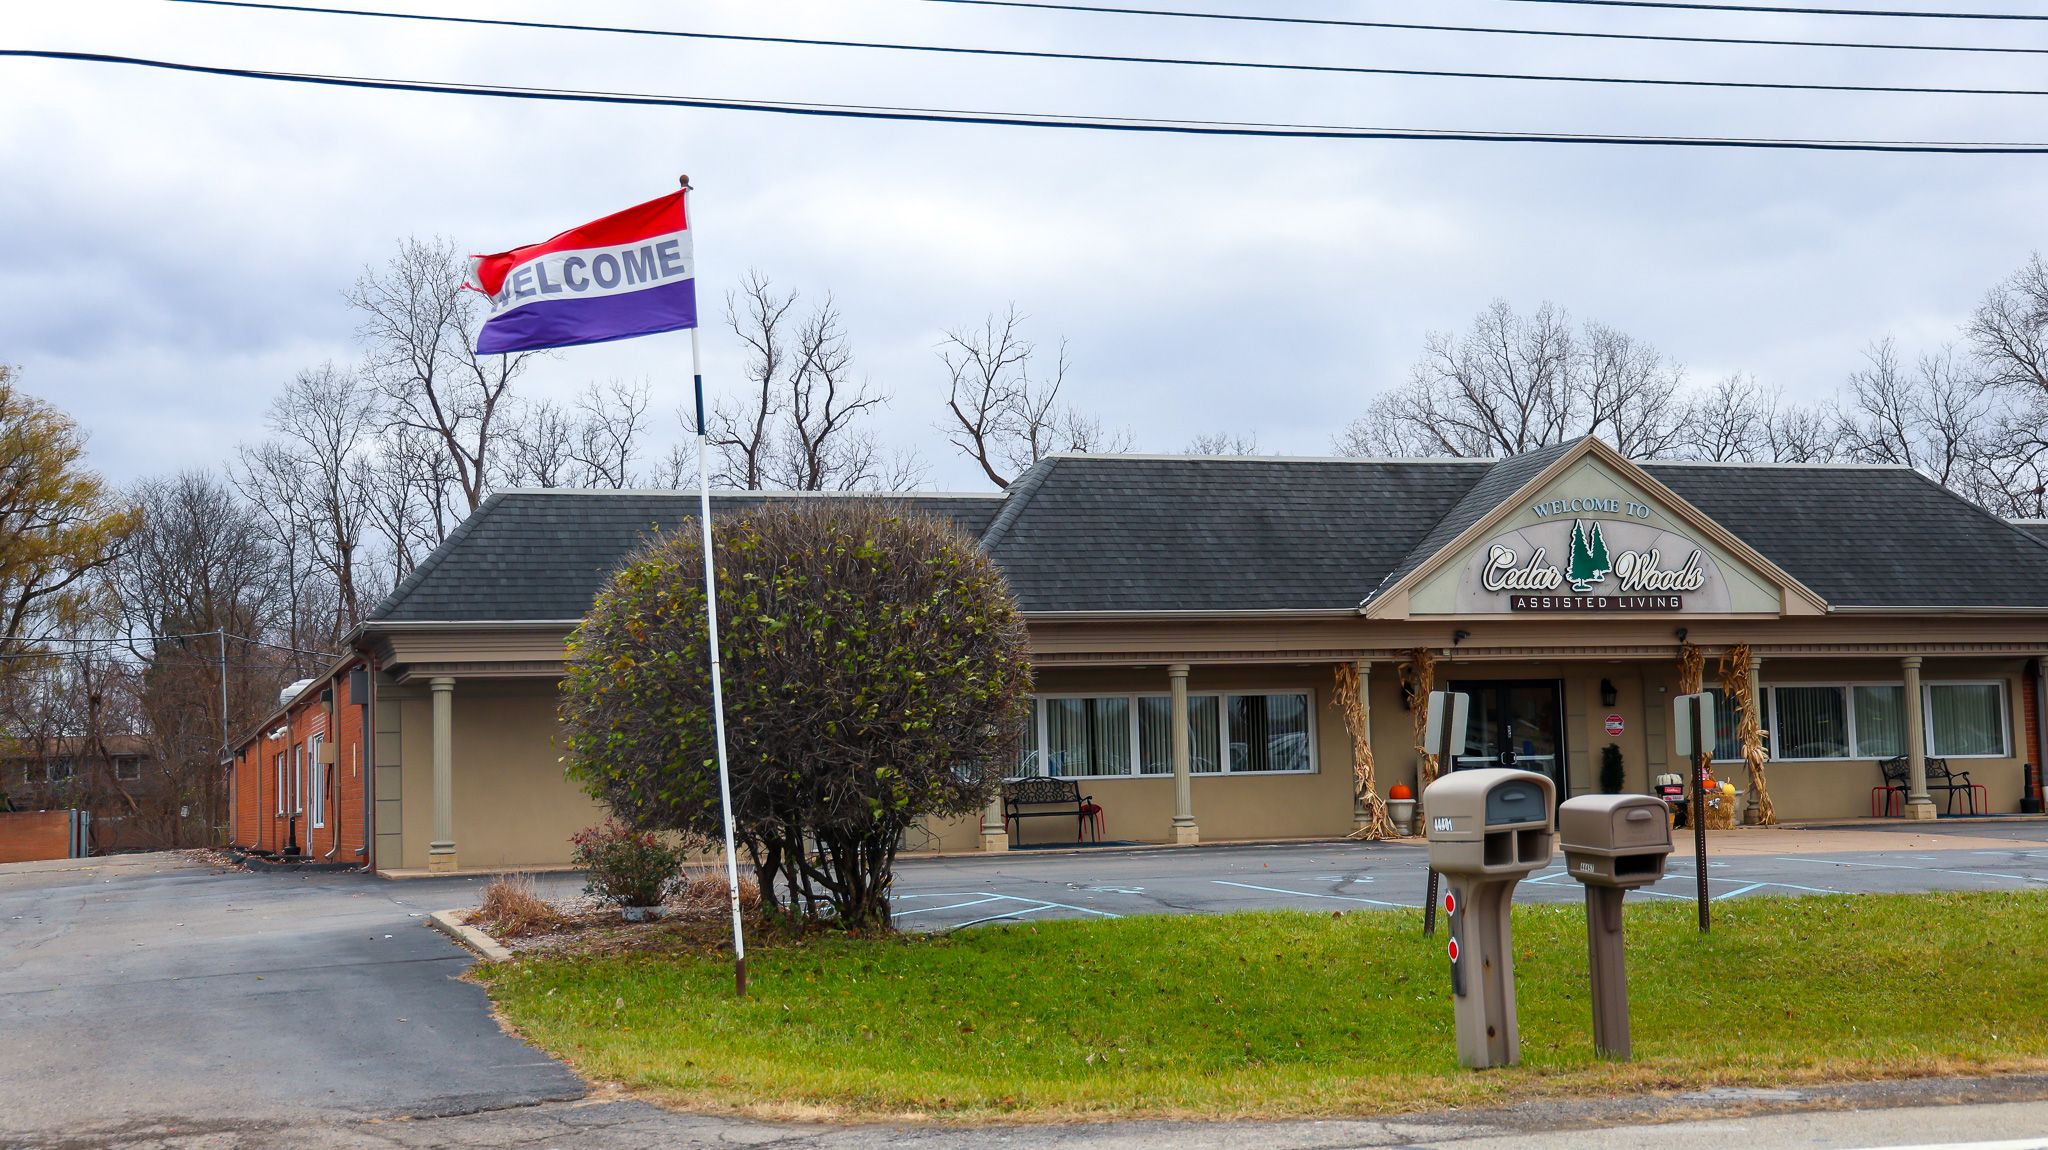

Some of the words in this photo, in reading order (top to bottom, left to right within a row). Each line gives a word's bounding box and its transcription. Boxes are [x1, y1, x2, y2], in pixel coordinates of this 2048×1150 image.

[1533, 498, 1619, 518] WELCOME
[1626, 501, 1650, 519] TO
[1482, 544, 1562, 591] Cedar
[1614, 548, 1704, 591] Woods
[1517, 597, 1607, 609] ASSISTED
[1619, 596, 1680, 609] LIVING
